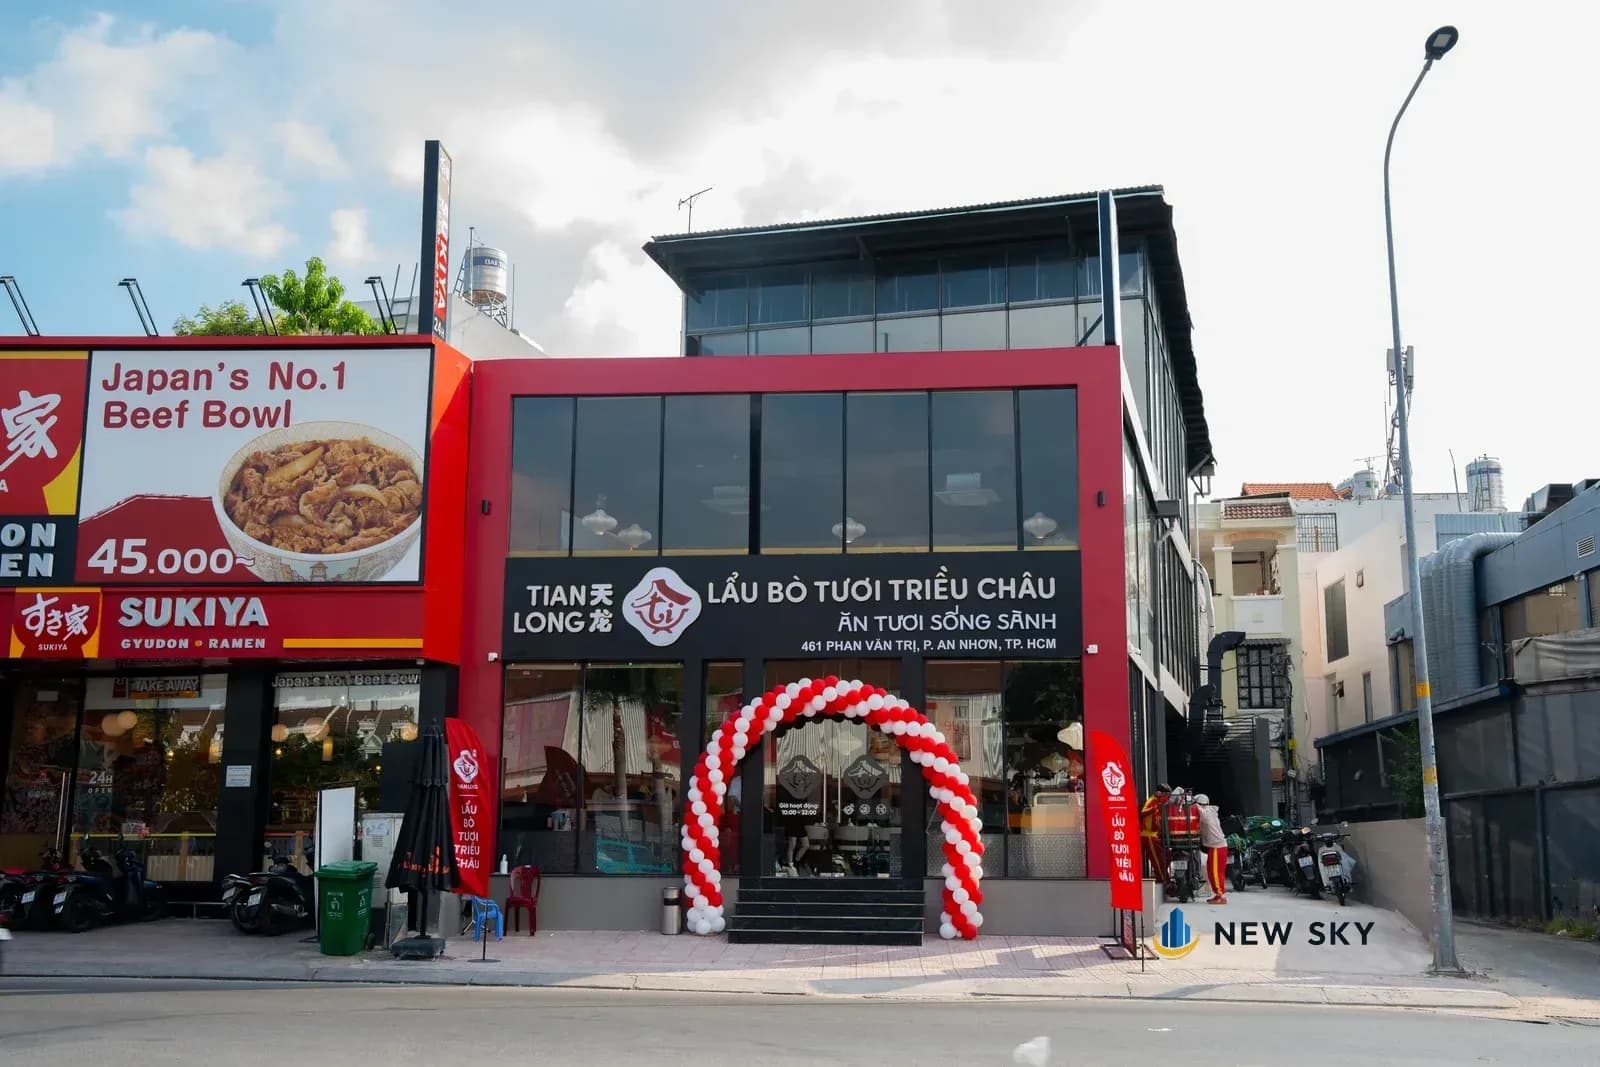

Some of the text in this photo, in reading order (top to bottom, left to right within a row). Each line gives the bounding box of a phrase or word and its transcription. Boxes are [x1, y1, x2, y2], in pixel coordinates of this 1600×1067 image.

[102, 361, 346, 395] Japan's No.1
[103, 399, 292, 428] Beef Bowl
[0, 522, 57, 548] ON
[0, 553, 55, 578] EN
[526, 584, 587, 607] TIAN
[589, 583, 614, 606] 天
[707, 565, 1056, 604] LẨU BÒ TƯƠI TRIỀU CHÂU
[21, 592, 90, 641] すき家
[118, 596, 269, 627] SUKIYA
[513, 611, 586, 633] LONG
[588, 608, 613, 633] 龙
[837, 611, 868, 632] ĂN
[873, 613, 924, 632] TƯƠI
[930, 604, 992, 631] SỐNG
[37, 643, 68, 651] SUKIYA
[121, 638, 266, 649] GYUDON RAMEN
[801, 638, 1057, 653] 461 PHAN VĂN TRỊ, P. AN NHƠN, TP. HCM
[136, 679, 166, 692] TAKE
[167, 678, 199, 692] AWAY
[89, 770, 113, 784] 24H
[463, 816, 475, 828] BÒ
